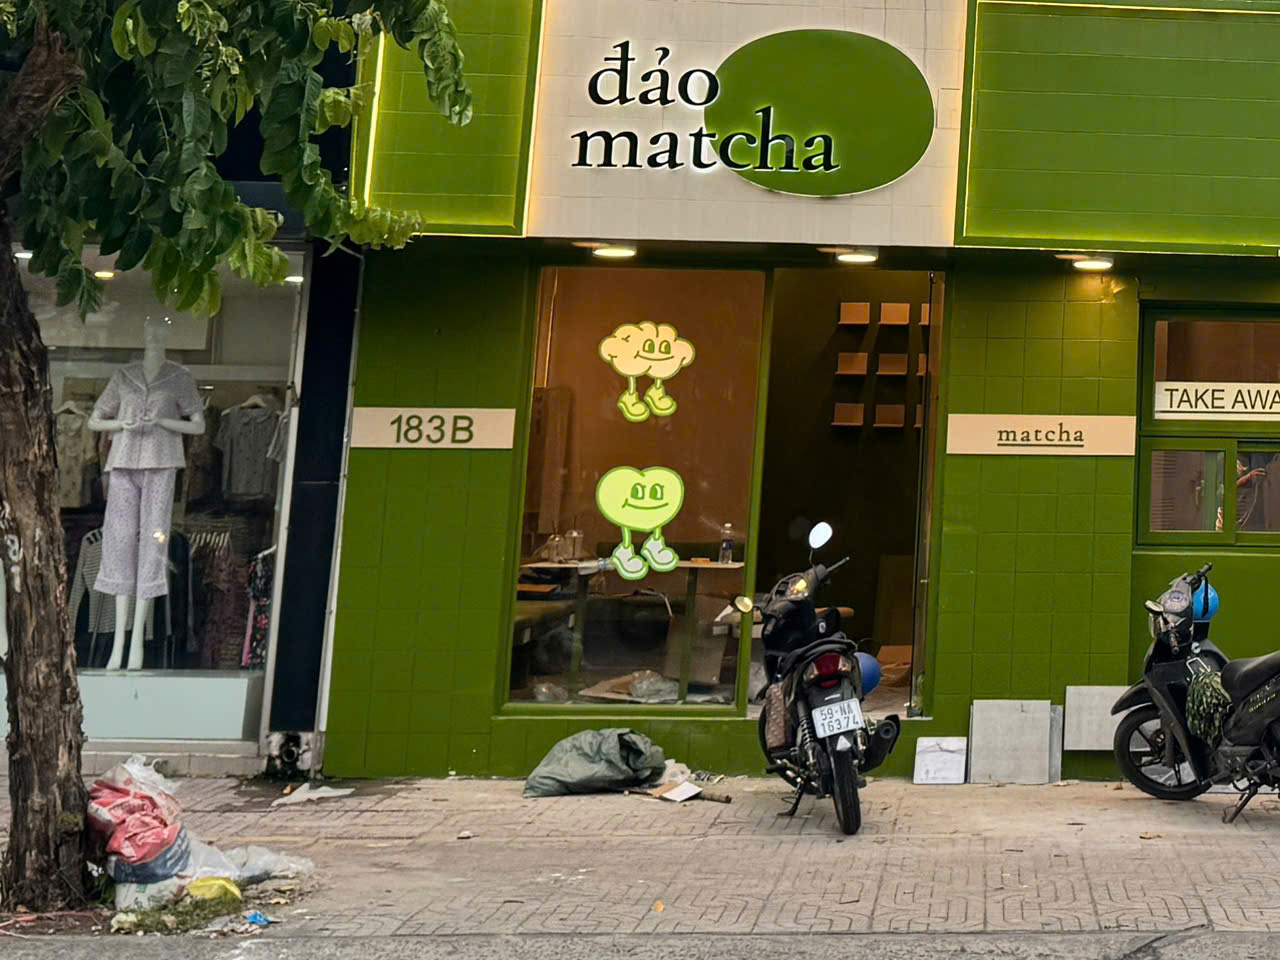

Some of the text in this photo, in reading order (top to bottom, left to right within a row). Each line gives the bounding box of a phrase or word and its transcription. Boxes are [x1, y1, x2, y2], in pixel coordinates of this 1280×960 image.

[588, 40, 720, 107] đảo
[570, 106, 839, 173] matcha
[1164, 388, 1225, 410] TAKE
[390, 414, 474, 444] 183B
[997, 422, 1084, 442] matcha
